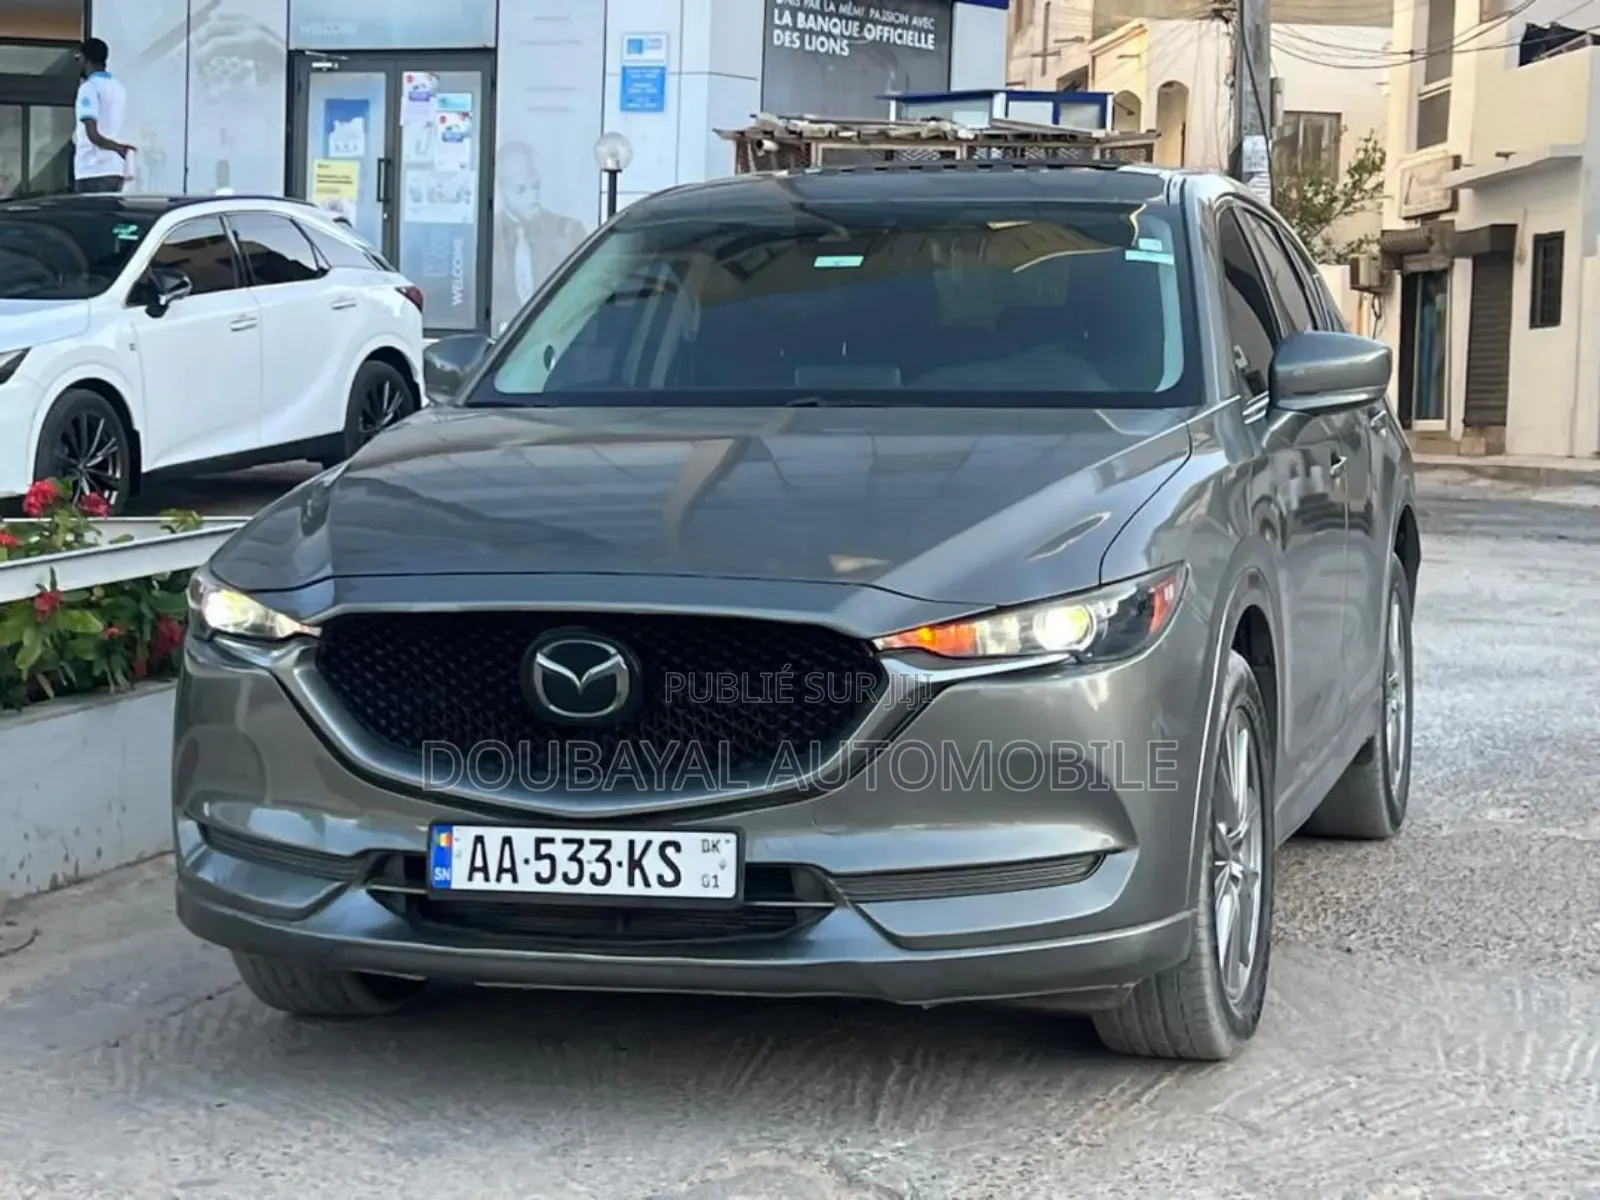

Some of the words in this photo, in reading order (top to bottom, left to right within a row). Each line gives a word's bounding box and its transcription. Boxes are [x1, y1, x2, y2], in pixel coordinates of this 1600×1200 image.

[823, 0, 836, 12] LA
[869, 7, 909, 24] PASSION
[911, 15, 935, 30] AVEC
[774, 8, 792, 27] LA
[797, 12, 860, 38] BANQUE
[864, 23, 935, 50] OFFICIELLE
[773, 29, 799, 49] DES
[804, 34, 850, 56] LIONS
[701, 838, 721, 853] DK
[434, 866, 451, 881] SN
[701, 873, 720, 888] 01
